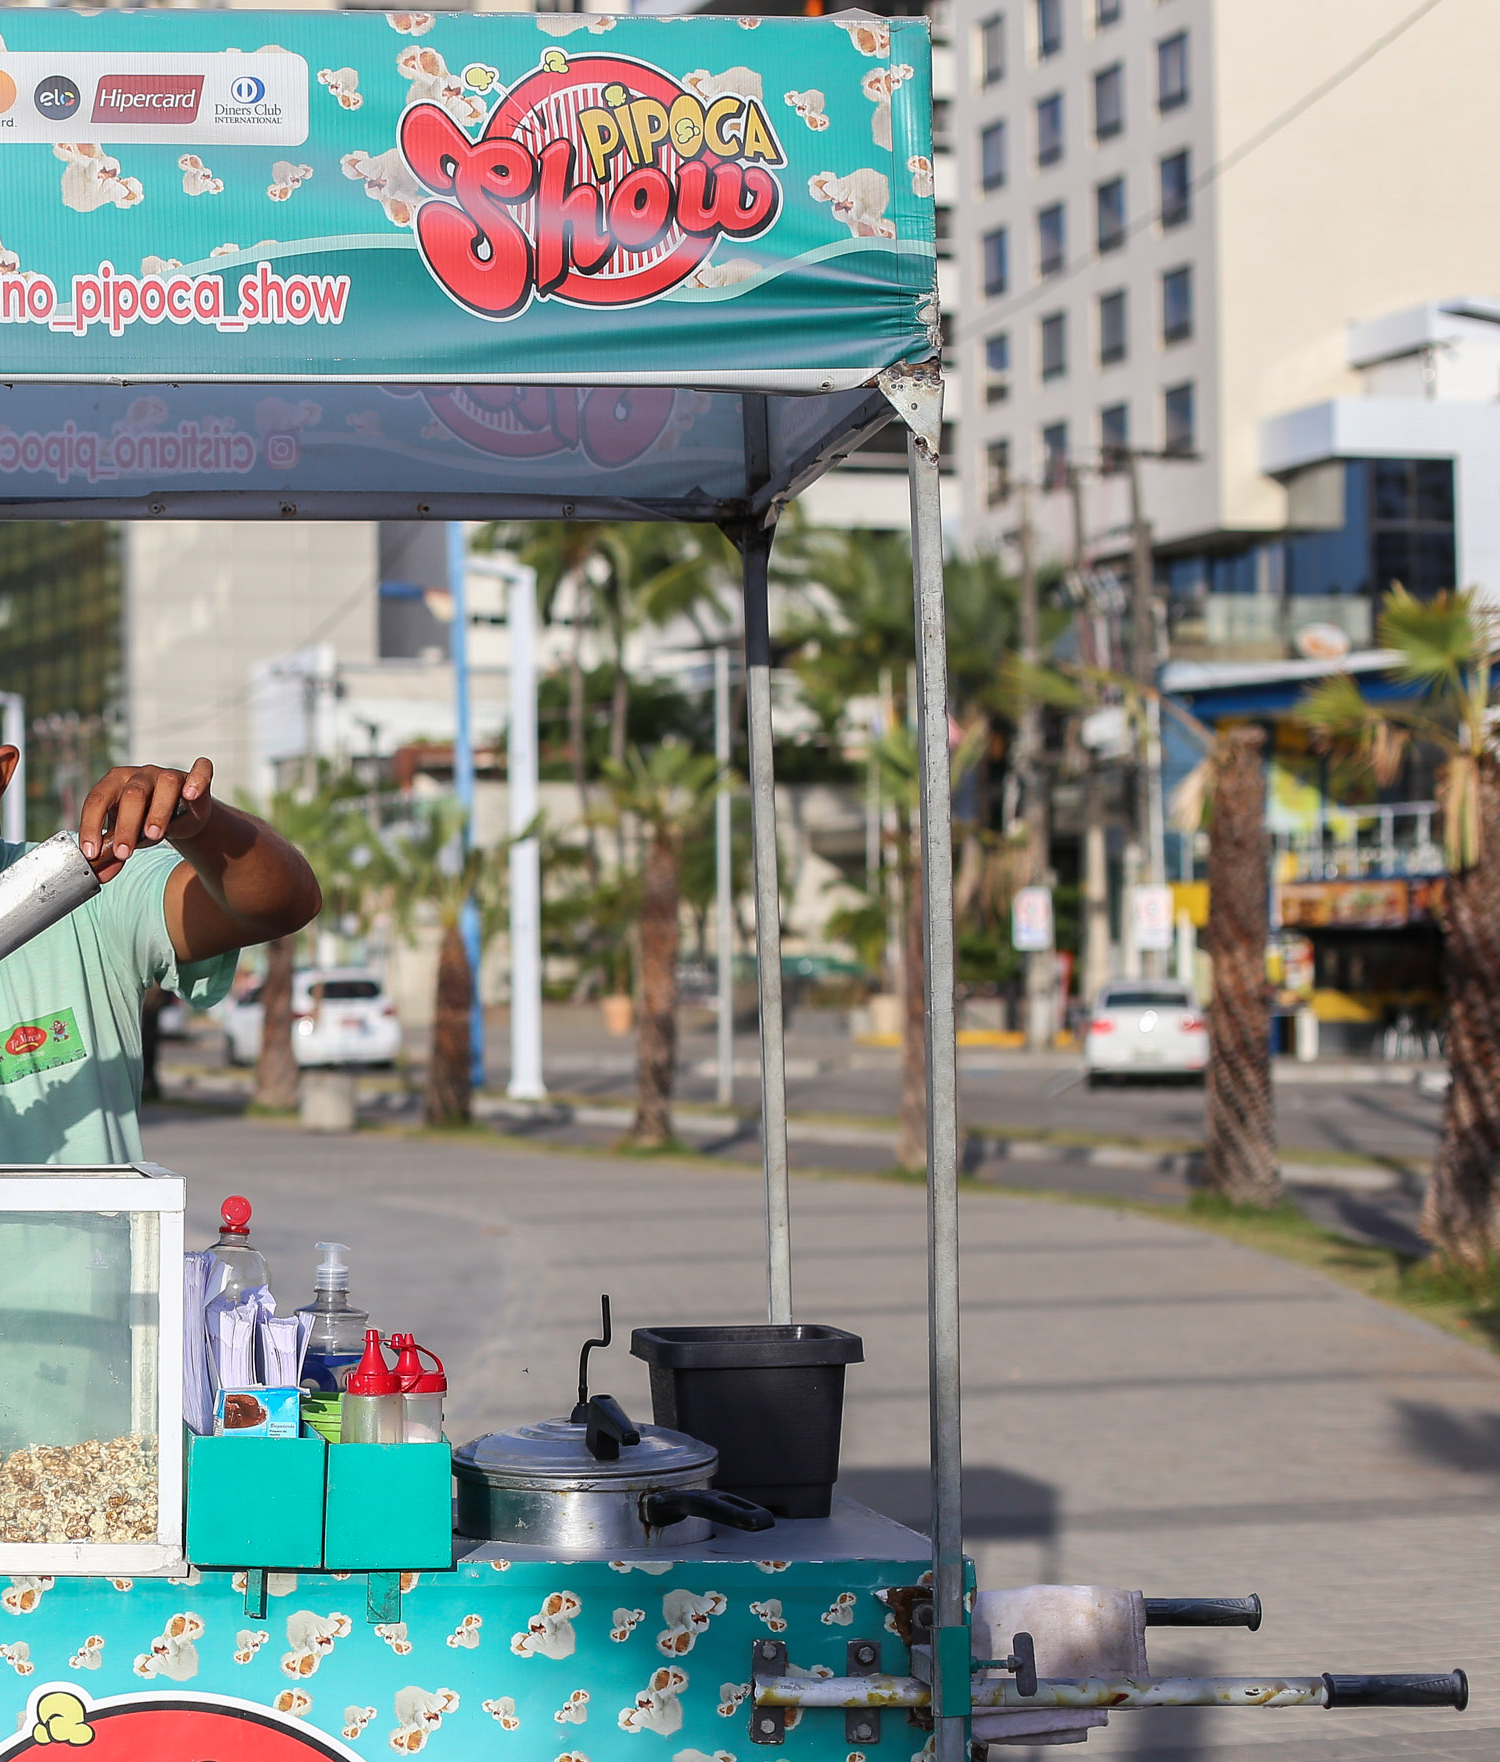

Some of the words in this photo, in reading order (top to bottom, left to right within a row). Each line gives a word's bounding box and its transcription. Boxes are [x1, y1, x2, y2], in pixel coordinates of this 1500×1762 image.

[39, 88, 75, 107] elo
[99, 88, 196, 113] Hipercard
[214, 104, 251, 116] Diners
[254, 103, 282, 116] Club
[214, 116, 283, 124] INTERNATIONAL
[399, 102, 782, 320] Show
